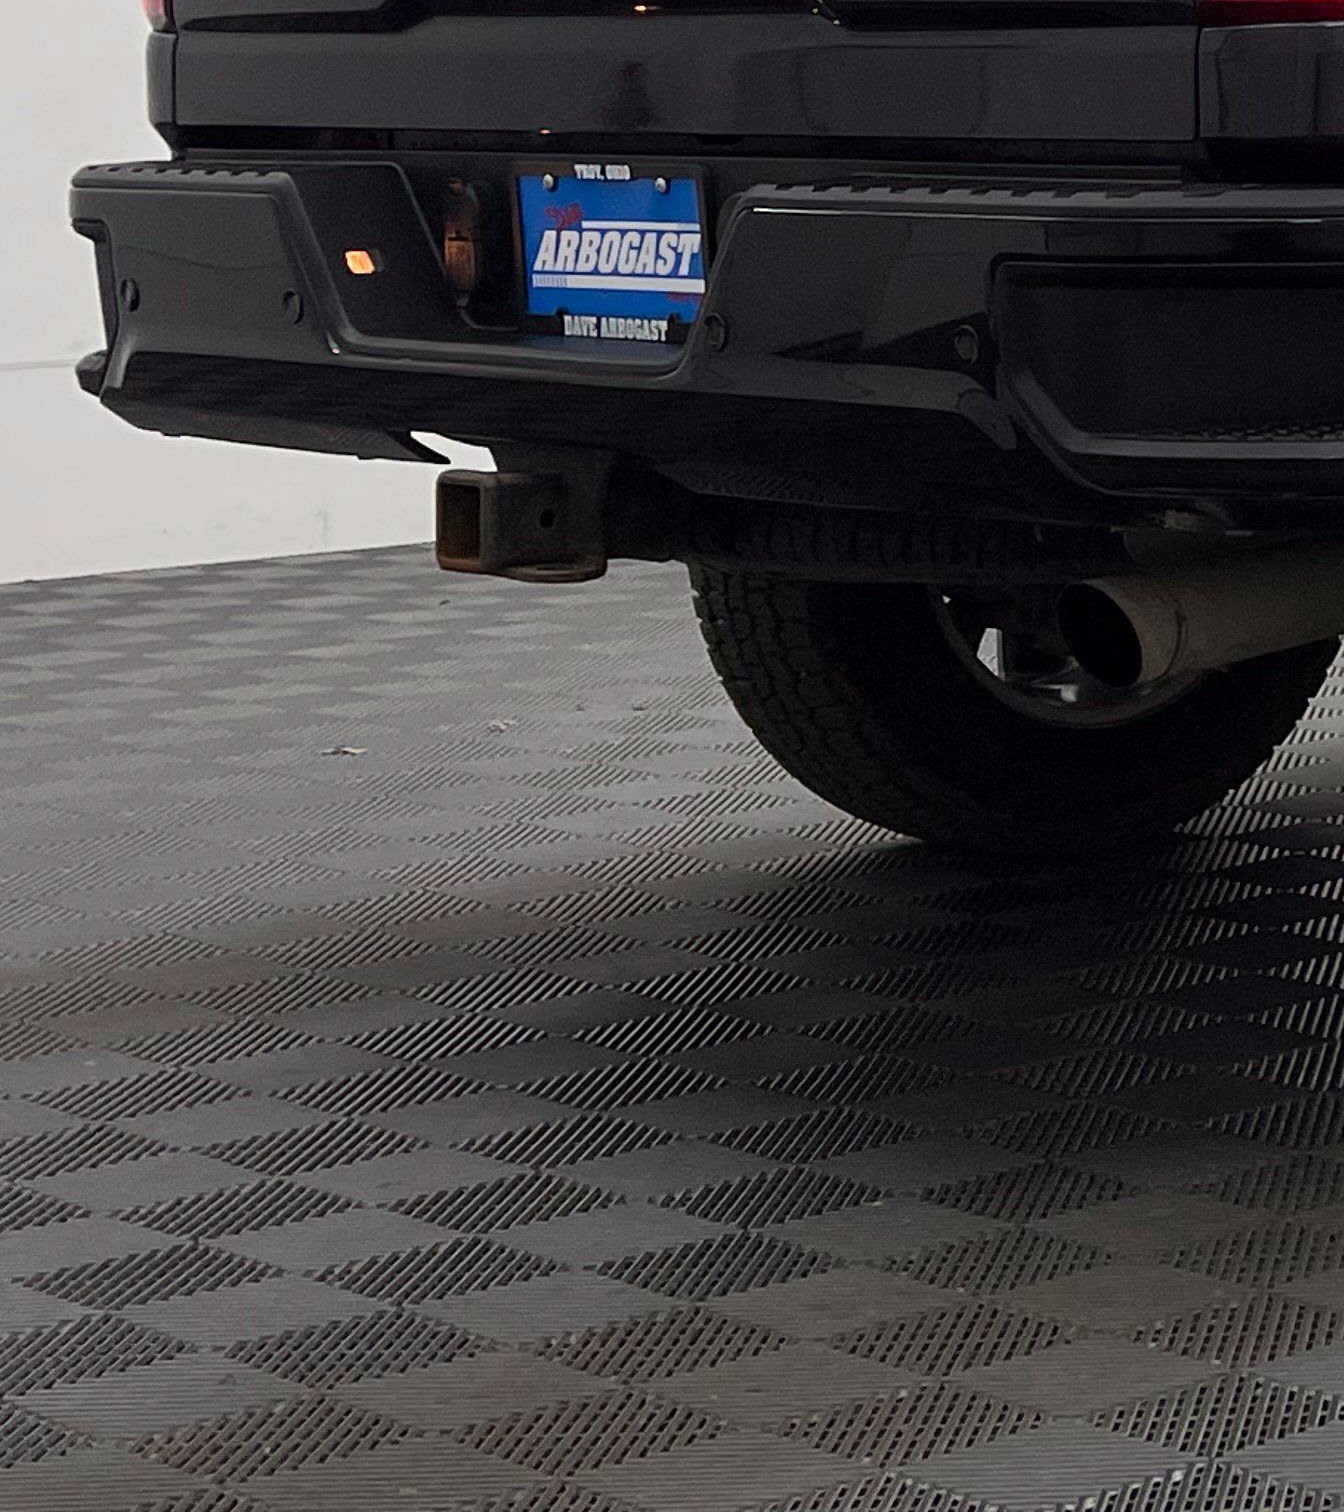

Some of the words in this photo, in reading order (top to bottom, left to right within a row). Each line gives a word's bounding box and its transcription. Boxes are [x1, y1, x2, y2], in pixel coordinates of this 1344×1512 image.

[532, 229, 702, 276] ARBOGAST
[563, 314, 598, 338] DAVE
[600, 316, 669, 342] ARBOGAST
